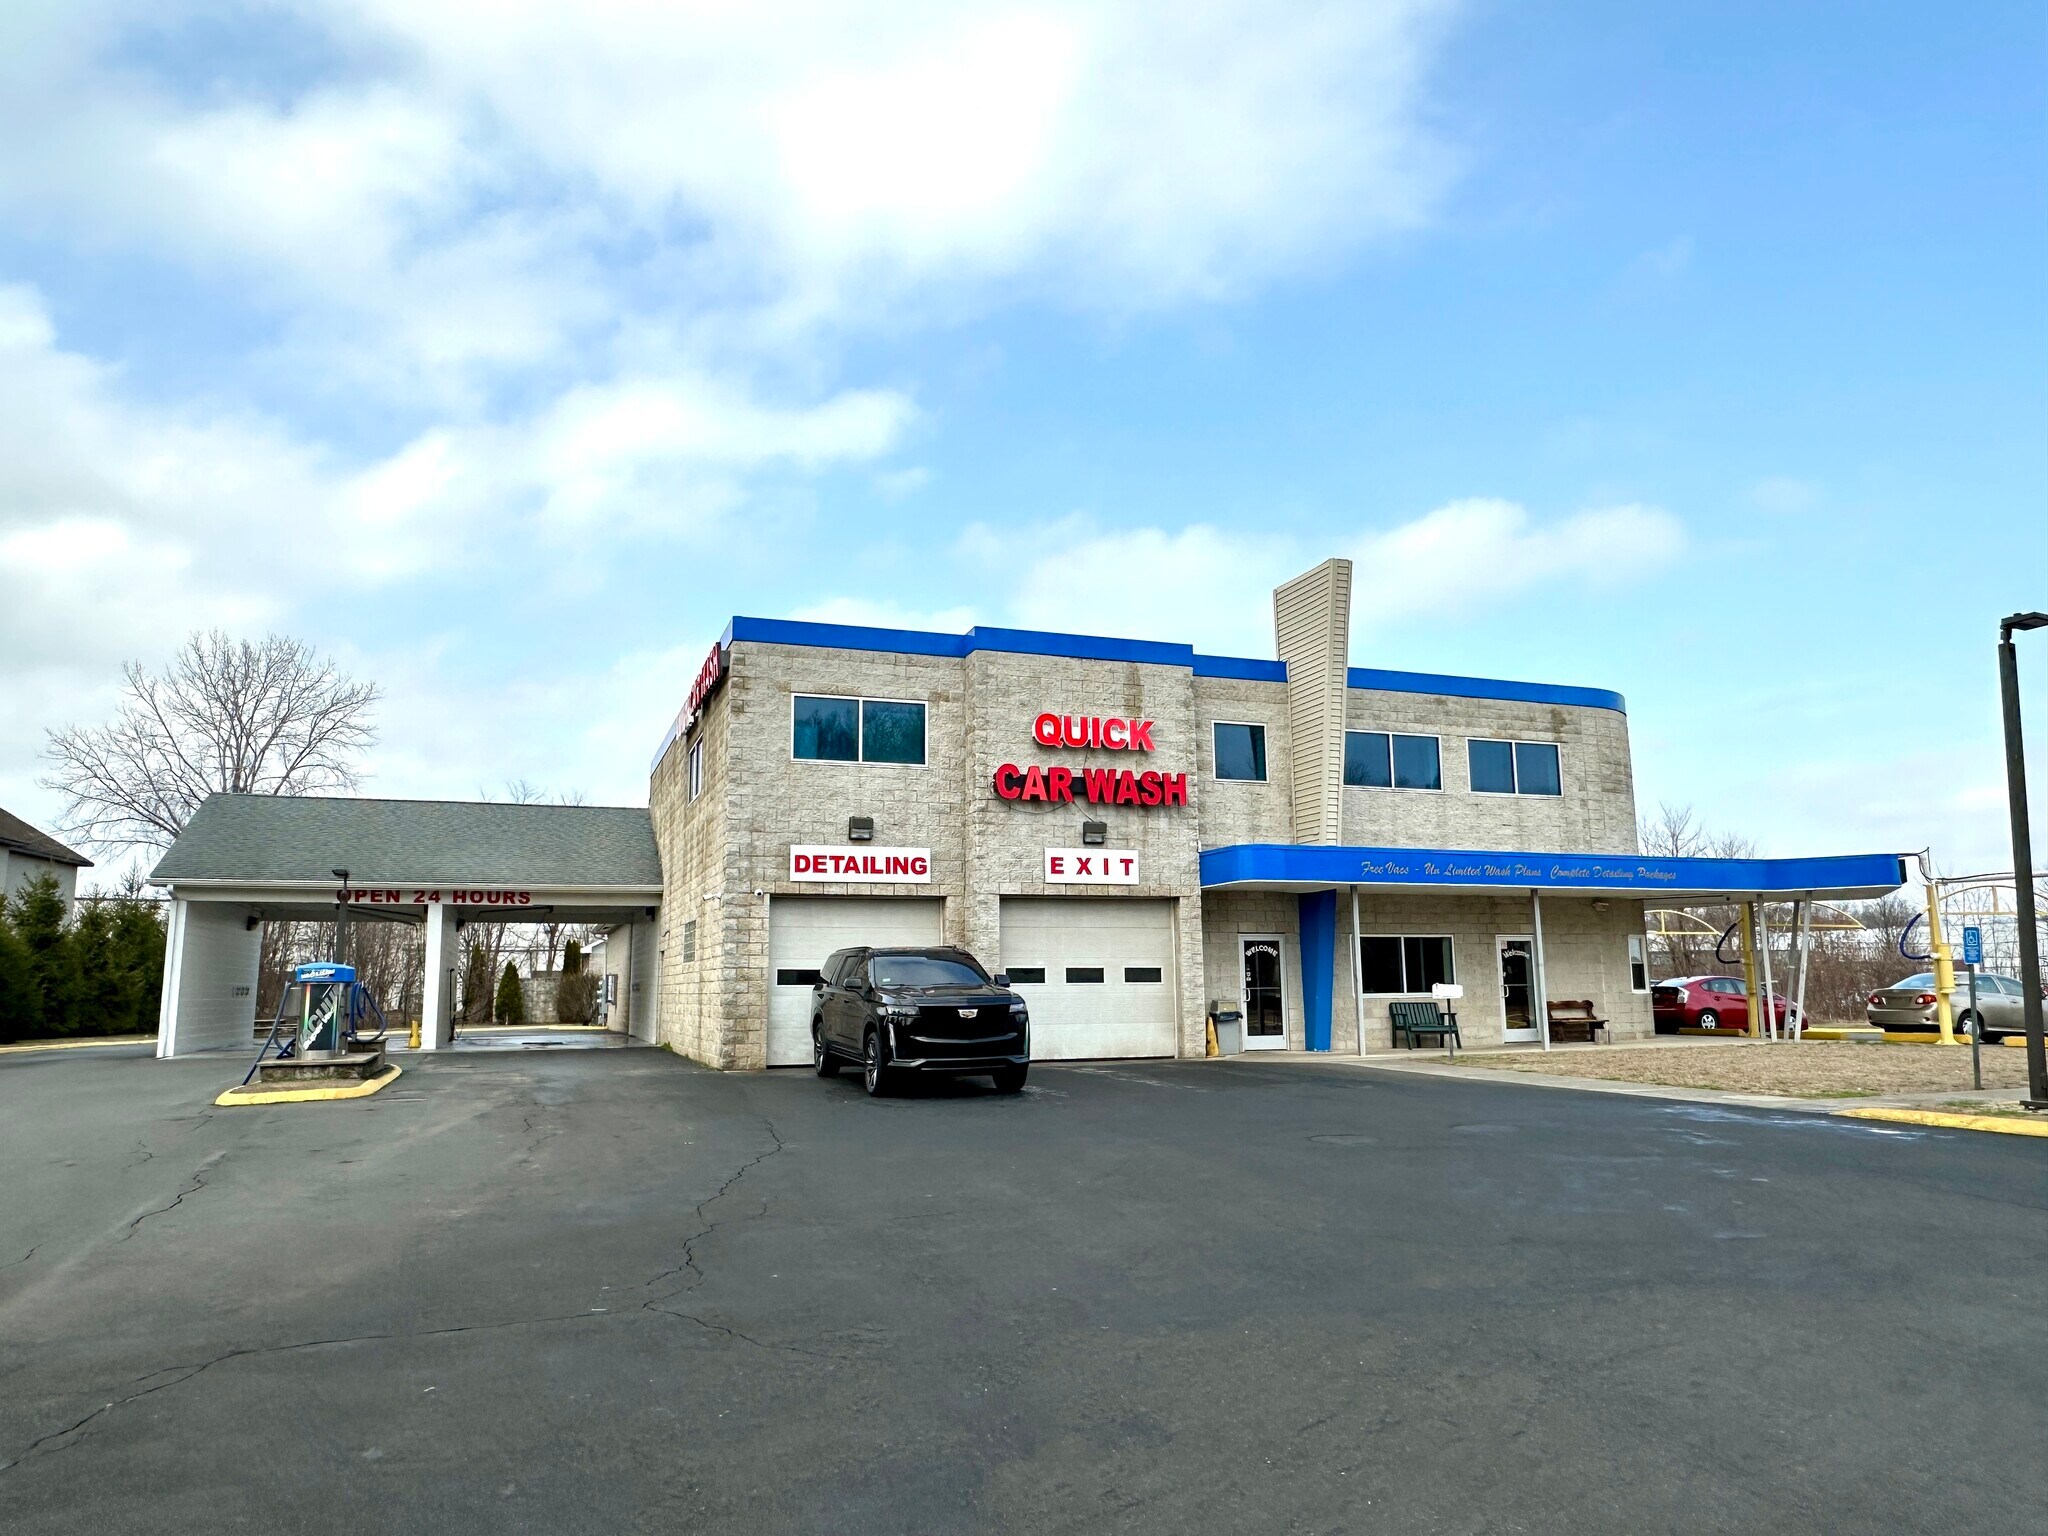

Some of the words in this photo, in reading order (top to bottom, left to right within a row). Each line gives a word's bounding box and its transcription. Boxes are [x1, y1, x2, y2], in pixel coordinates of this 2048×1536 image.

[1032, 713, 1156, 752] QUICK
[993, 763, 1075, 804] CAR
[1082, 768, 1188, 807] WASH
[794, 854, 928, 876] DETAILING
[1050, 856, 1135, 876] EXIT
[1361, 861, 1384, 876] Free
[1385, 861, 1409, 875] Vacs
[1443, 863, 1482, 877] Limited
[1484, 864, 1511, 877] Wash
[1514, 864, 1541, 878] Plans
[1550, 865, 1590, 880] Complete
[1637, 866, 1676, 882] Packages
[337, 889, 401, 904] OPEN
[413, 889, 441, 904] 24
[452, 890, 531, 905] HOURS
[1245, 945, 1278, 957] WELCOME
